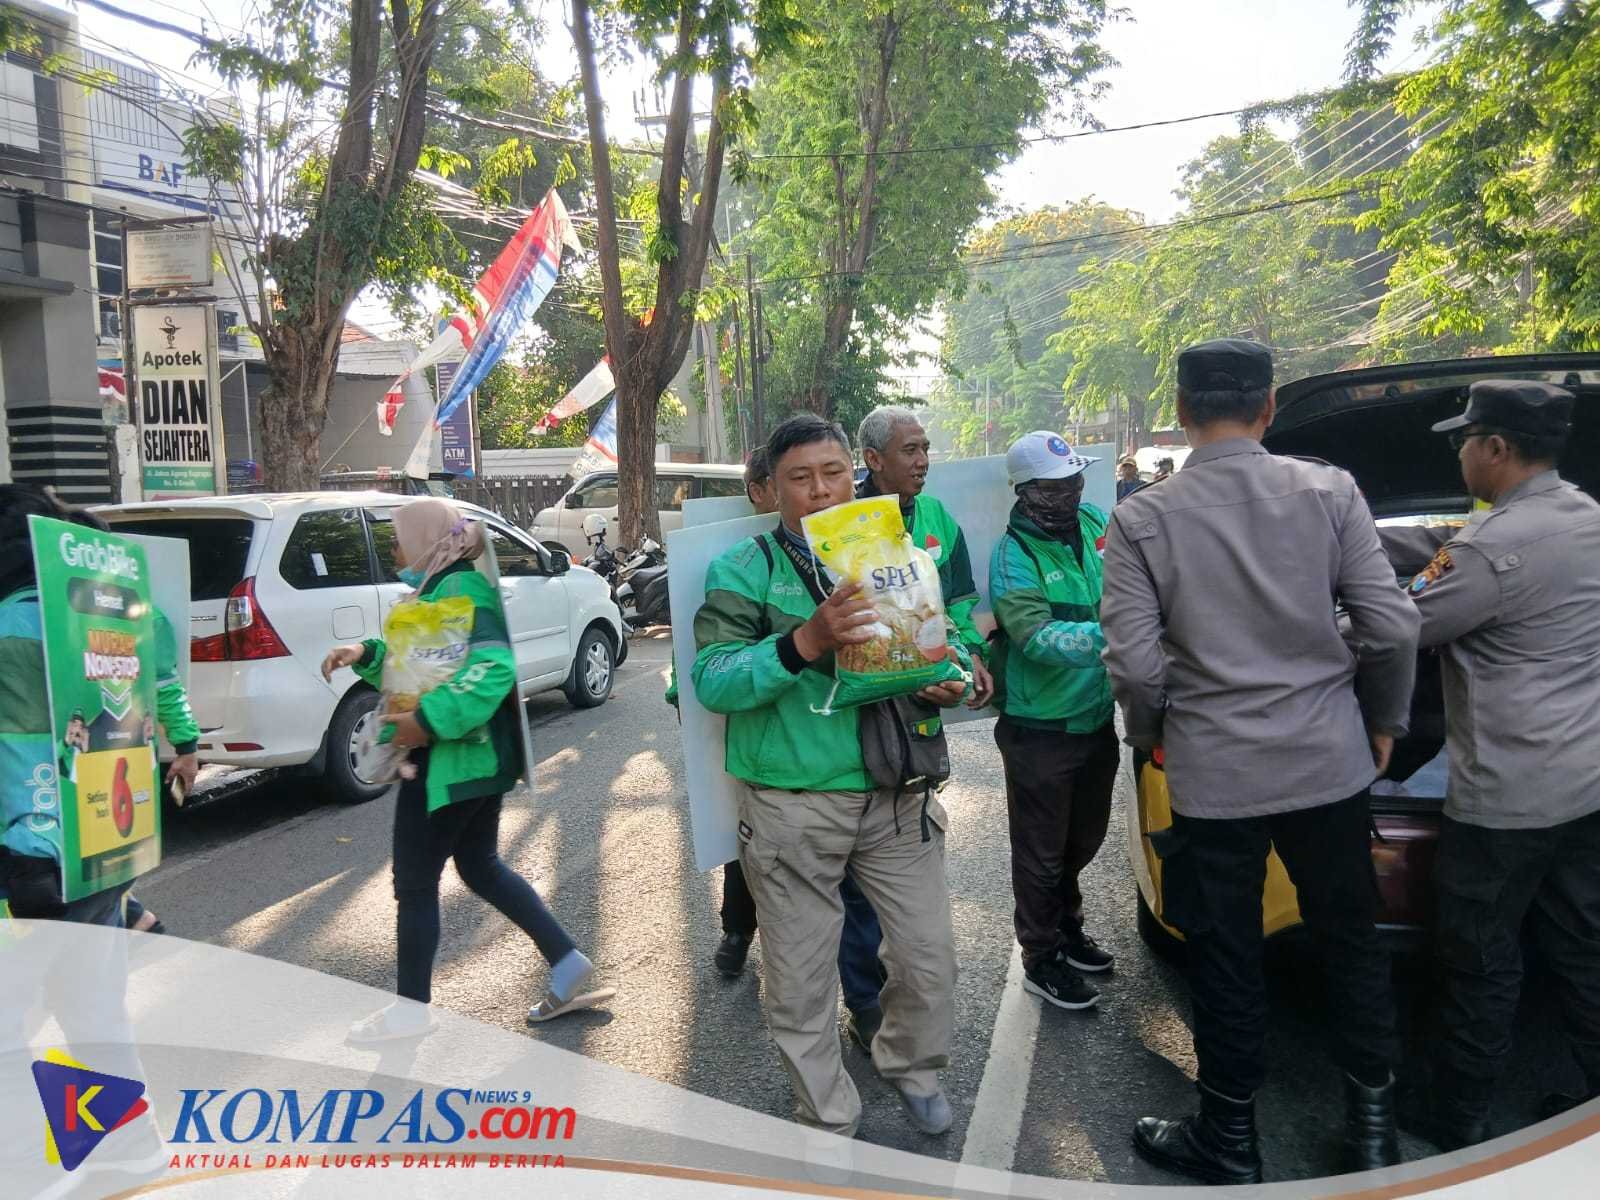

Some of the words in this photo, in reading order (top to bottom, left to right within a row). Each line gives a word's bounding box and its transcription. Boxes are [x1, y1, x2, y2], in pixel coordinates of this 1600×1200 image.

[138, 153, 185, 188] BAF
[142, 351, 202, 369] Apotek
[142, 379, 208, 424] DIAN
[144, 430, 211, 463] SEJAHTERA
[444, 448, 465, 459] ATM
[783, 541, 813, 574] SAMSUNG
[1036, 625, 1094, 653] Grab
[112, 757, 134, 838] 6
